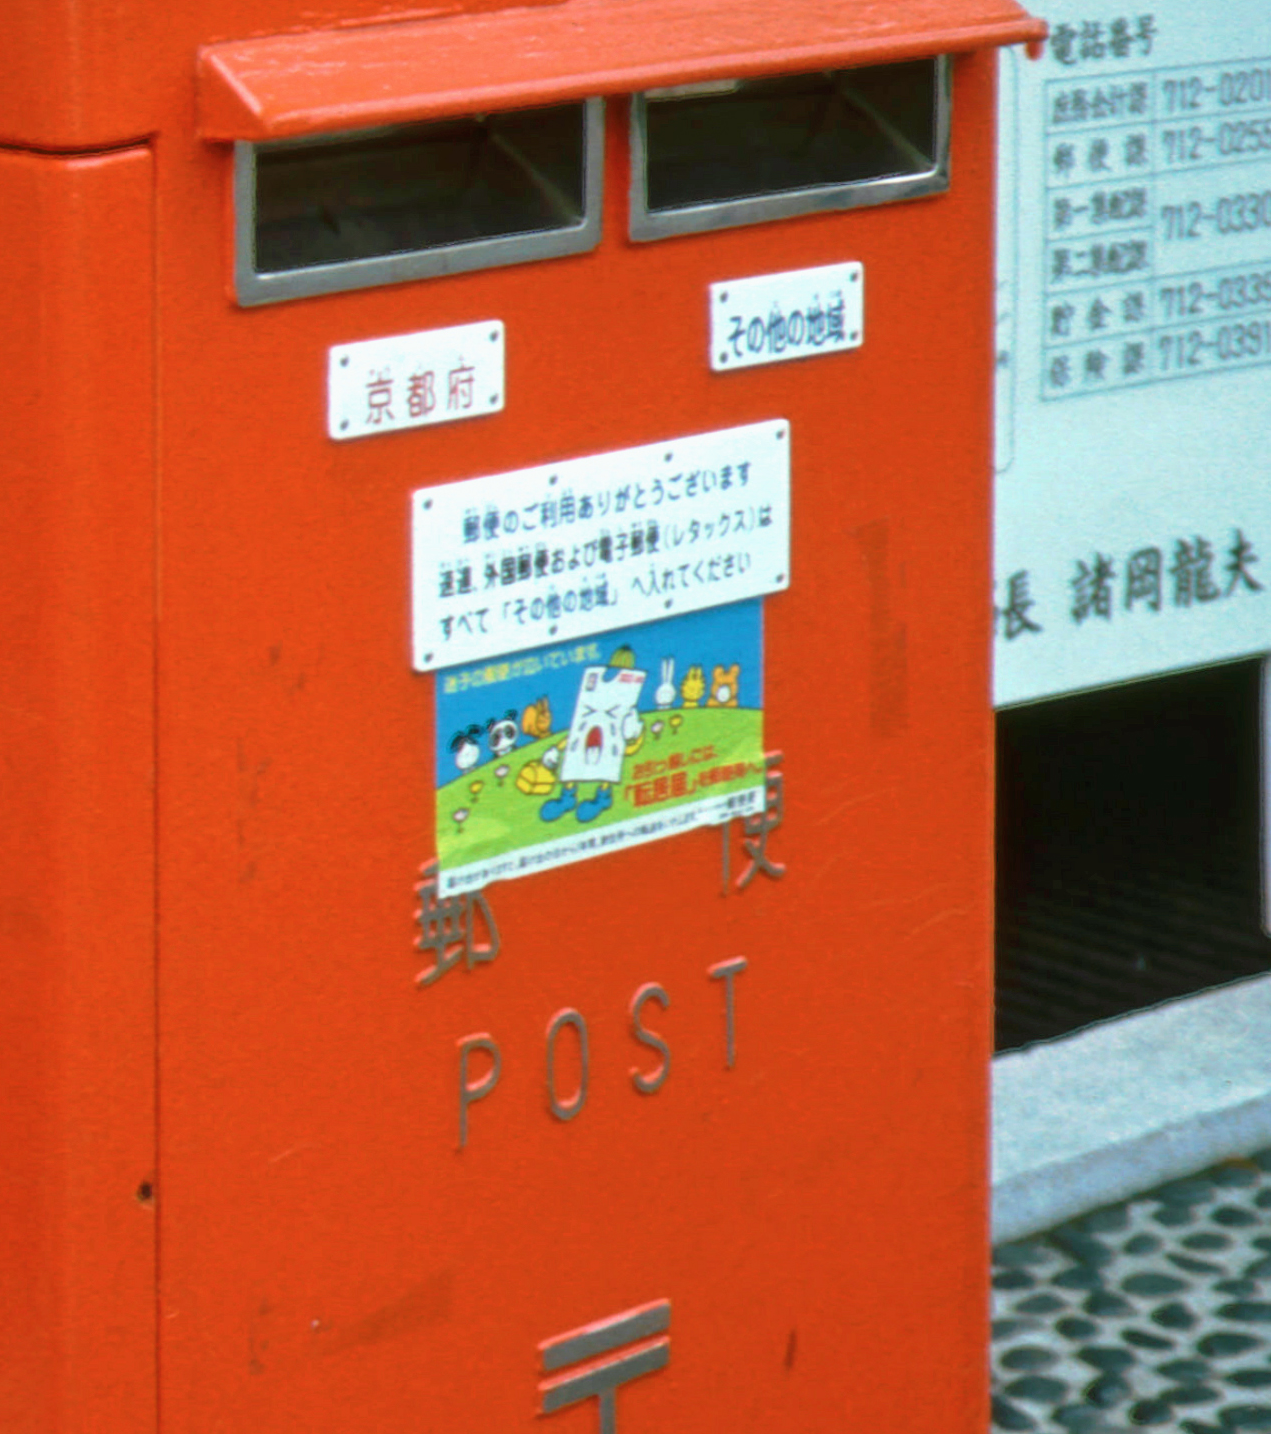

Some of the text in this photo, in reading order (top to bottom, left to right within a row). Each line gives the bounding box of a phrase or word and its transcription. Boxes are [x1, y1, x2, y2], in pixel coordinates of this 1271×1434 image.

[727, 297, 847, 357] その他の地域
[462, 460, 753, 546] 郵便のご利用ありがとうございます
[994, 569, 1043, 641] 長
[454, 954, 748, 1151] POST
